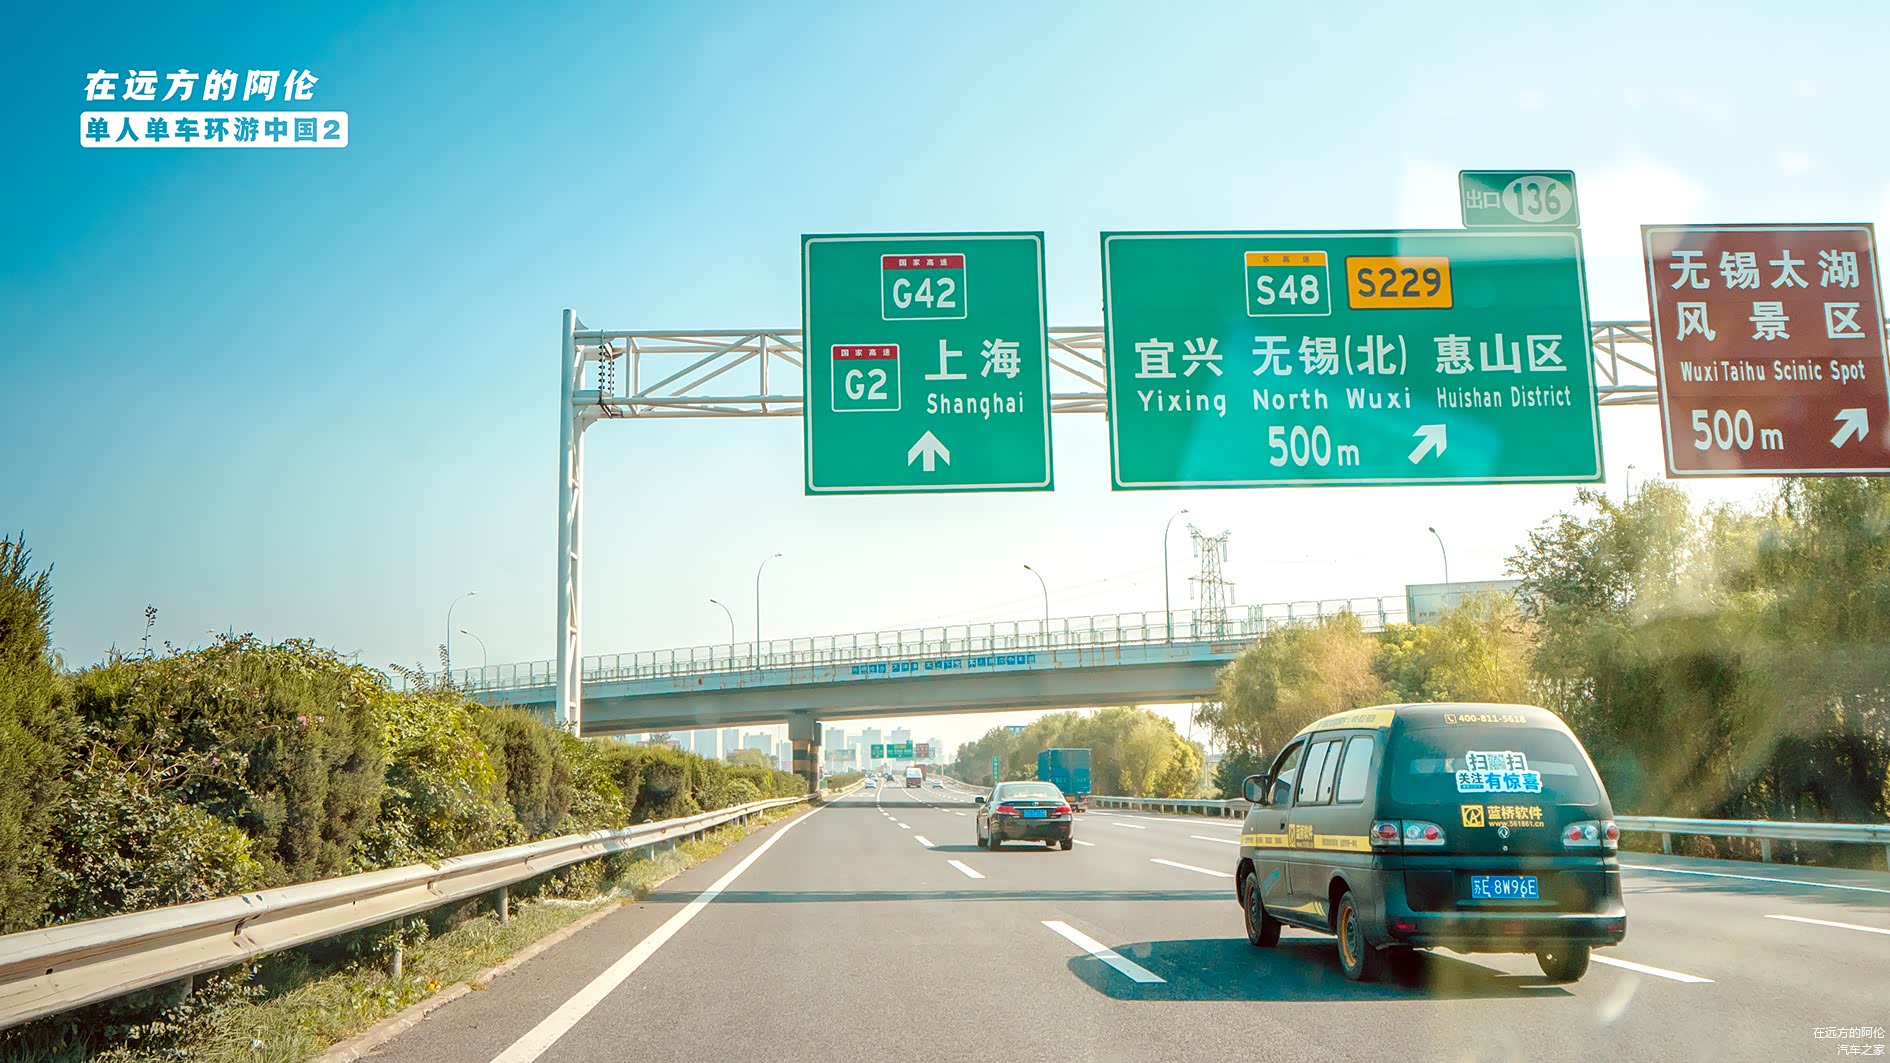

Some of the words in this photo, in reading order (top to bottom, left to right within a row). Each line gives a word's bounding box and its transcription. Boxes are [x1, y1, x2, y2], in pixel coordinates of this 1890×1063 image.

[1467, 190, 1500, 209] 出口
[1513, 182, 1562, 216] 136
[1357, 267, 1442, 298] S229
[1669, 249, 1860, 290] 无锡太湖
[893, 277, 956, 309] G42
[1256, 274, 1320, 305] S48
[1676, 301, 1866, 342] 风景区
[924, 338, 1022, 381] 上海
[1134, 337, 1224, 379] 宜兴
[1252, 334, 1407, 376] 无锡(北)
[1433, 333, 1567, 375] 惠山区
[1680, 361, 1718, 382] Wuxi
[1721, 361, 1766, 382] Taihu
[1773, 359, 1823, 381] Scinic
[1830, 359, 1866, 385] Spot
[845, 368, 888, 400] G2
[926, 391, 1024, 420] Shanghai
[1137, 389, 1227, 418] Yixing
[1253, 388, 1329, 411] North
[1346, 386, 1411, 409] Wuxi
[1436, 386, 1503, 408] Huishan
[1510, 384, 1571, 408] District
[1484, 772, 1540, 791] 有惊喜
[1487, 805, 1543, 820] 蓝桥软件
